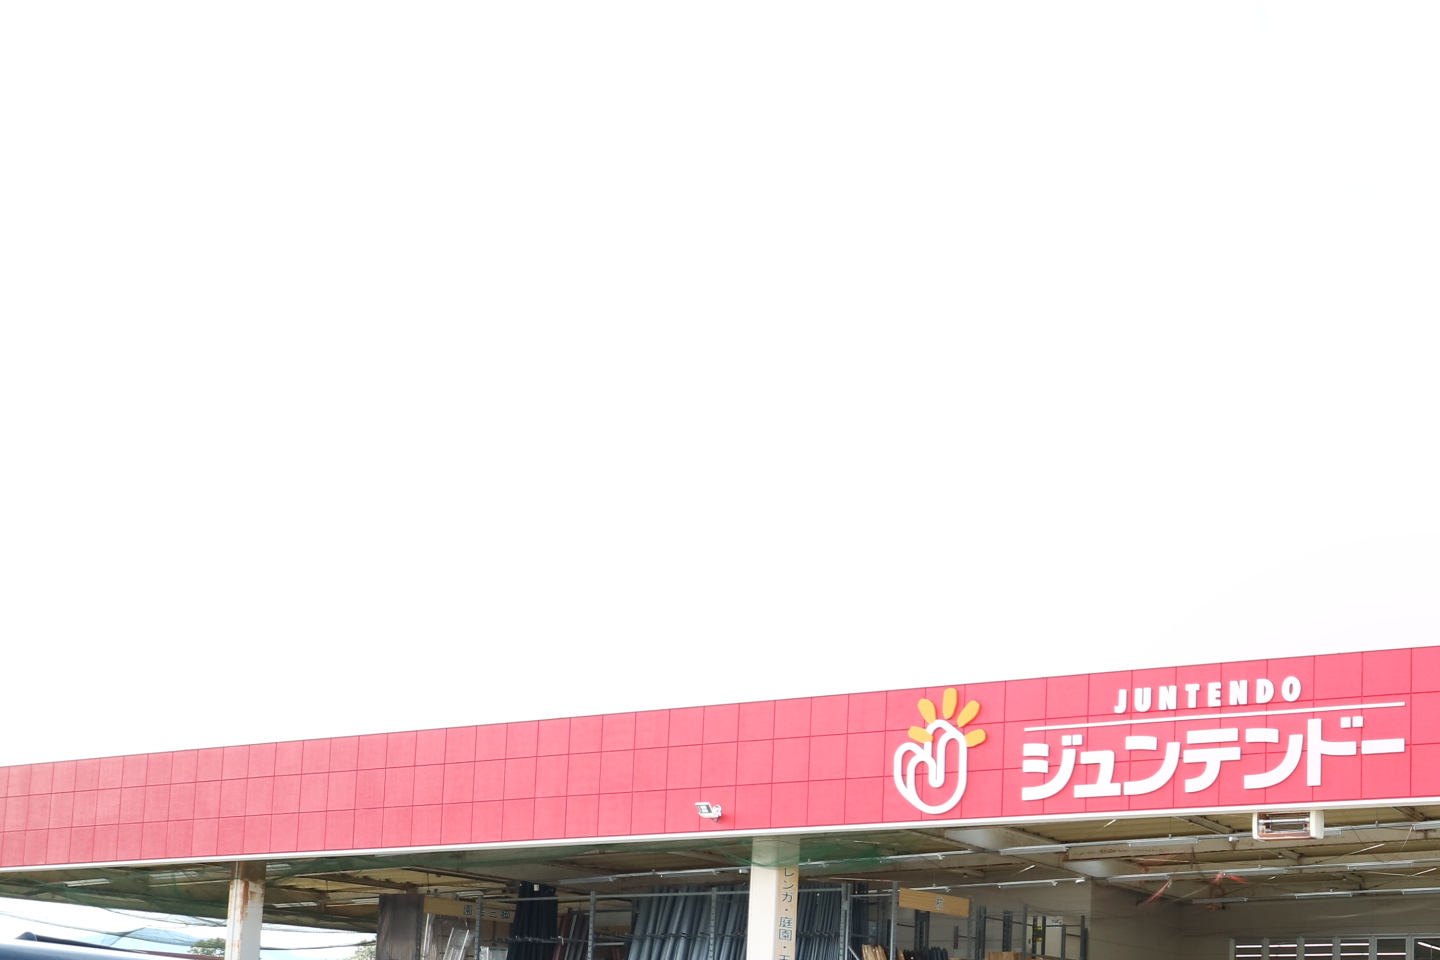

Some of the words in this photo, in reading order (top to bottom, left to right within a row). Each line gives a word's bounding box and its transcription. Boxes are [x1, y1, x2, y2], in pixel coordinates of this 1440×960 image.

[1113, 676, 1301, 714] JUNTENDO
[1021, 716, 1406, 801] ジュンテンドー
